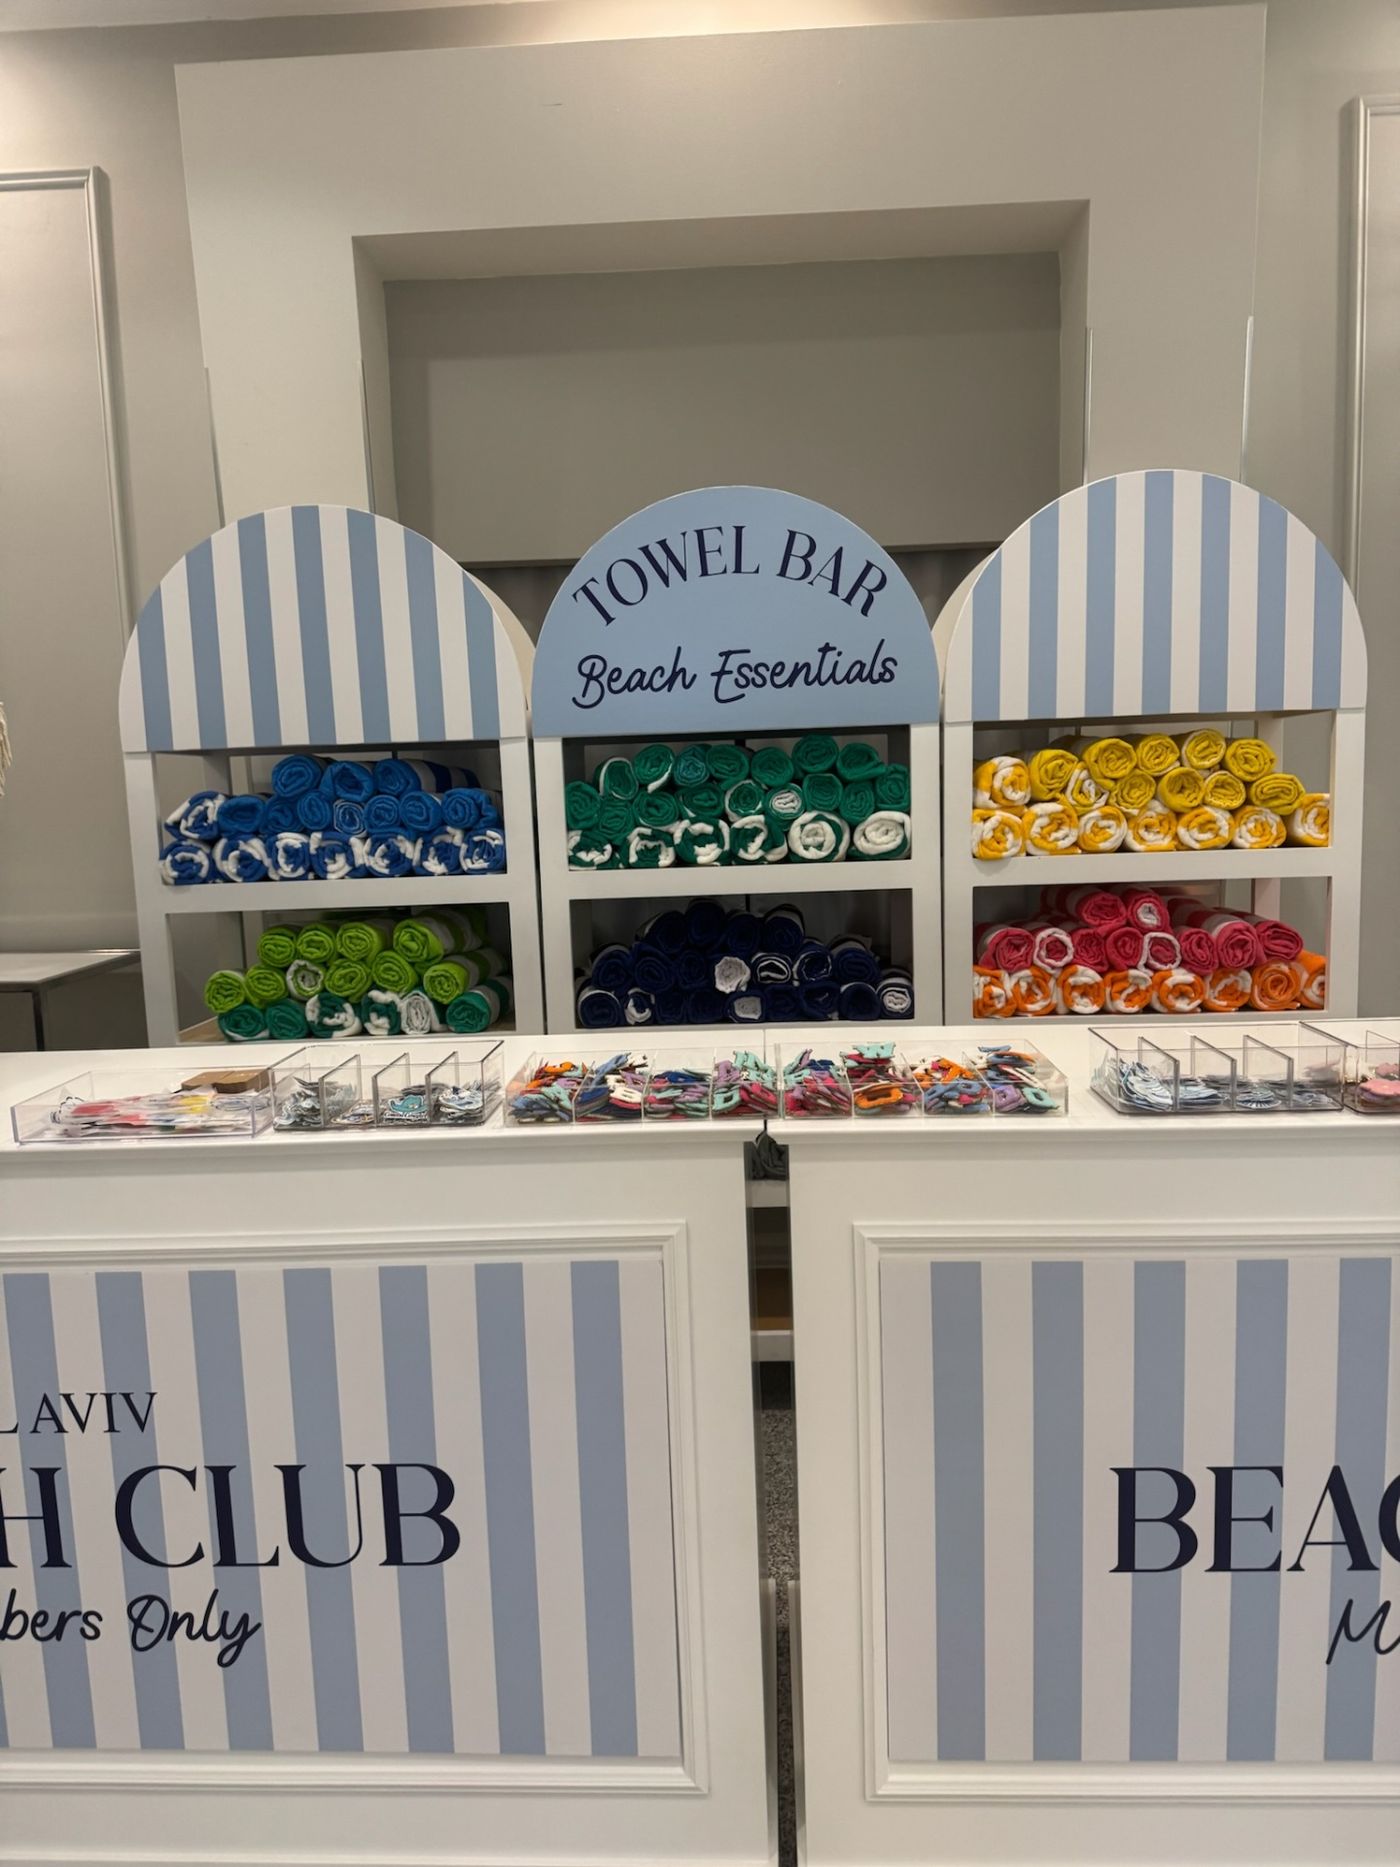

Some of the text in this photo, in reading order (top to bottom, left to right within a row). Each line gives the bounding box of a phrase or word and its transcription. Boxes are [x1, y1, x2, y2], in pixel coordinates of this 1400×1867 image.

[572, 526, 888, 626] TOWEL BAR
[572, 638, 898, 709] Beach Essentials
[30, 1392, 157, 1434] AVIV
[115, 1463, 461, 1568] CLUB
[127, 1588, 262, 1668] Only
